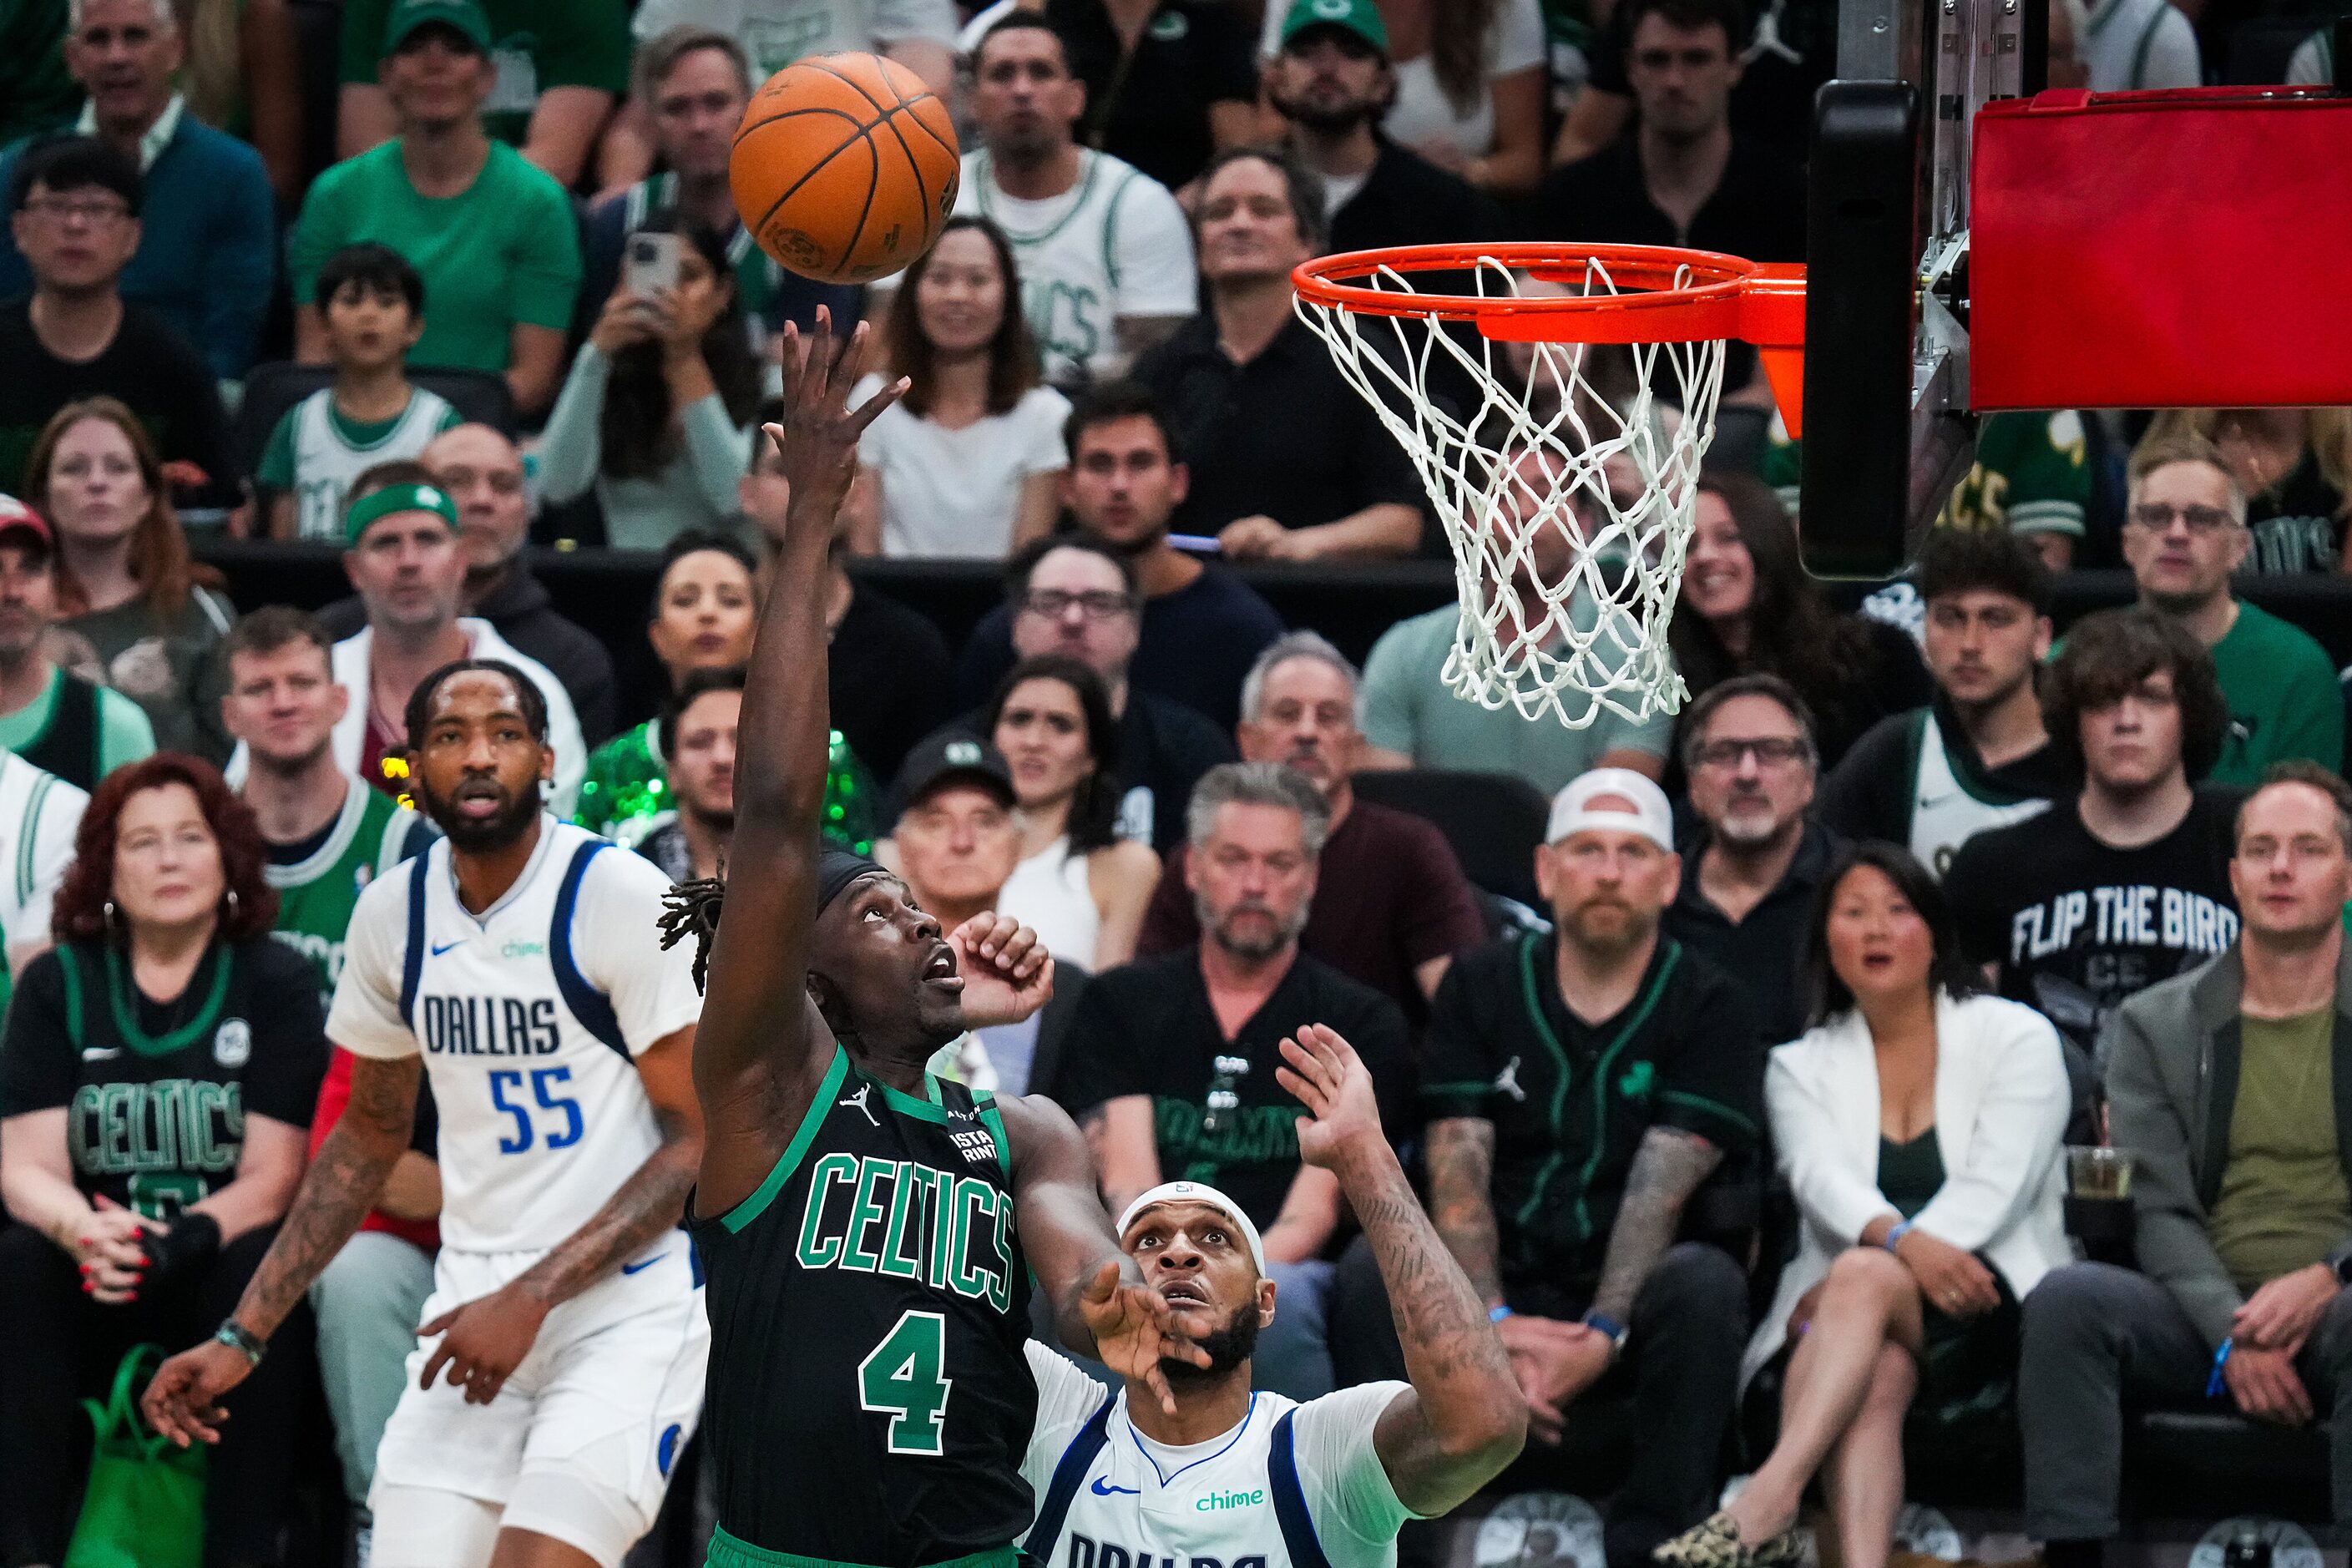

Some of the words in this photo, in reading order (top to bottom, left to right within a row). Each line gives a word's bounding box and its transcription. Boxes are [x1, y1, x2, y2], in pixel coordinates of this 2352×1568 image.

[2011, 890, 2087, 967] FLIP
[2092, 885, 2159, 946] THE
[2162, 887, 2239, 954] BIRD
[423, 995, 559, 1055] DALLAS
[487, 1065, 584, 1156] 55
[947, 1105, 981, 1121] ALTON
[948, 1130, 994, 1149] ISTA
[961, 1144, 998, 1163] RINT
[796, 1152, 1014, 1315] CELTICS
[857, 1309, 953, 1455] 4
[1196, 1489, 1264, 1512] chime
